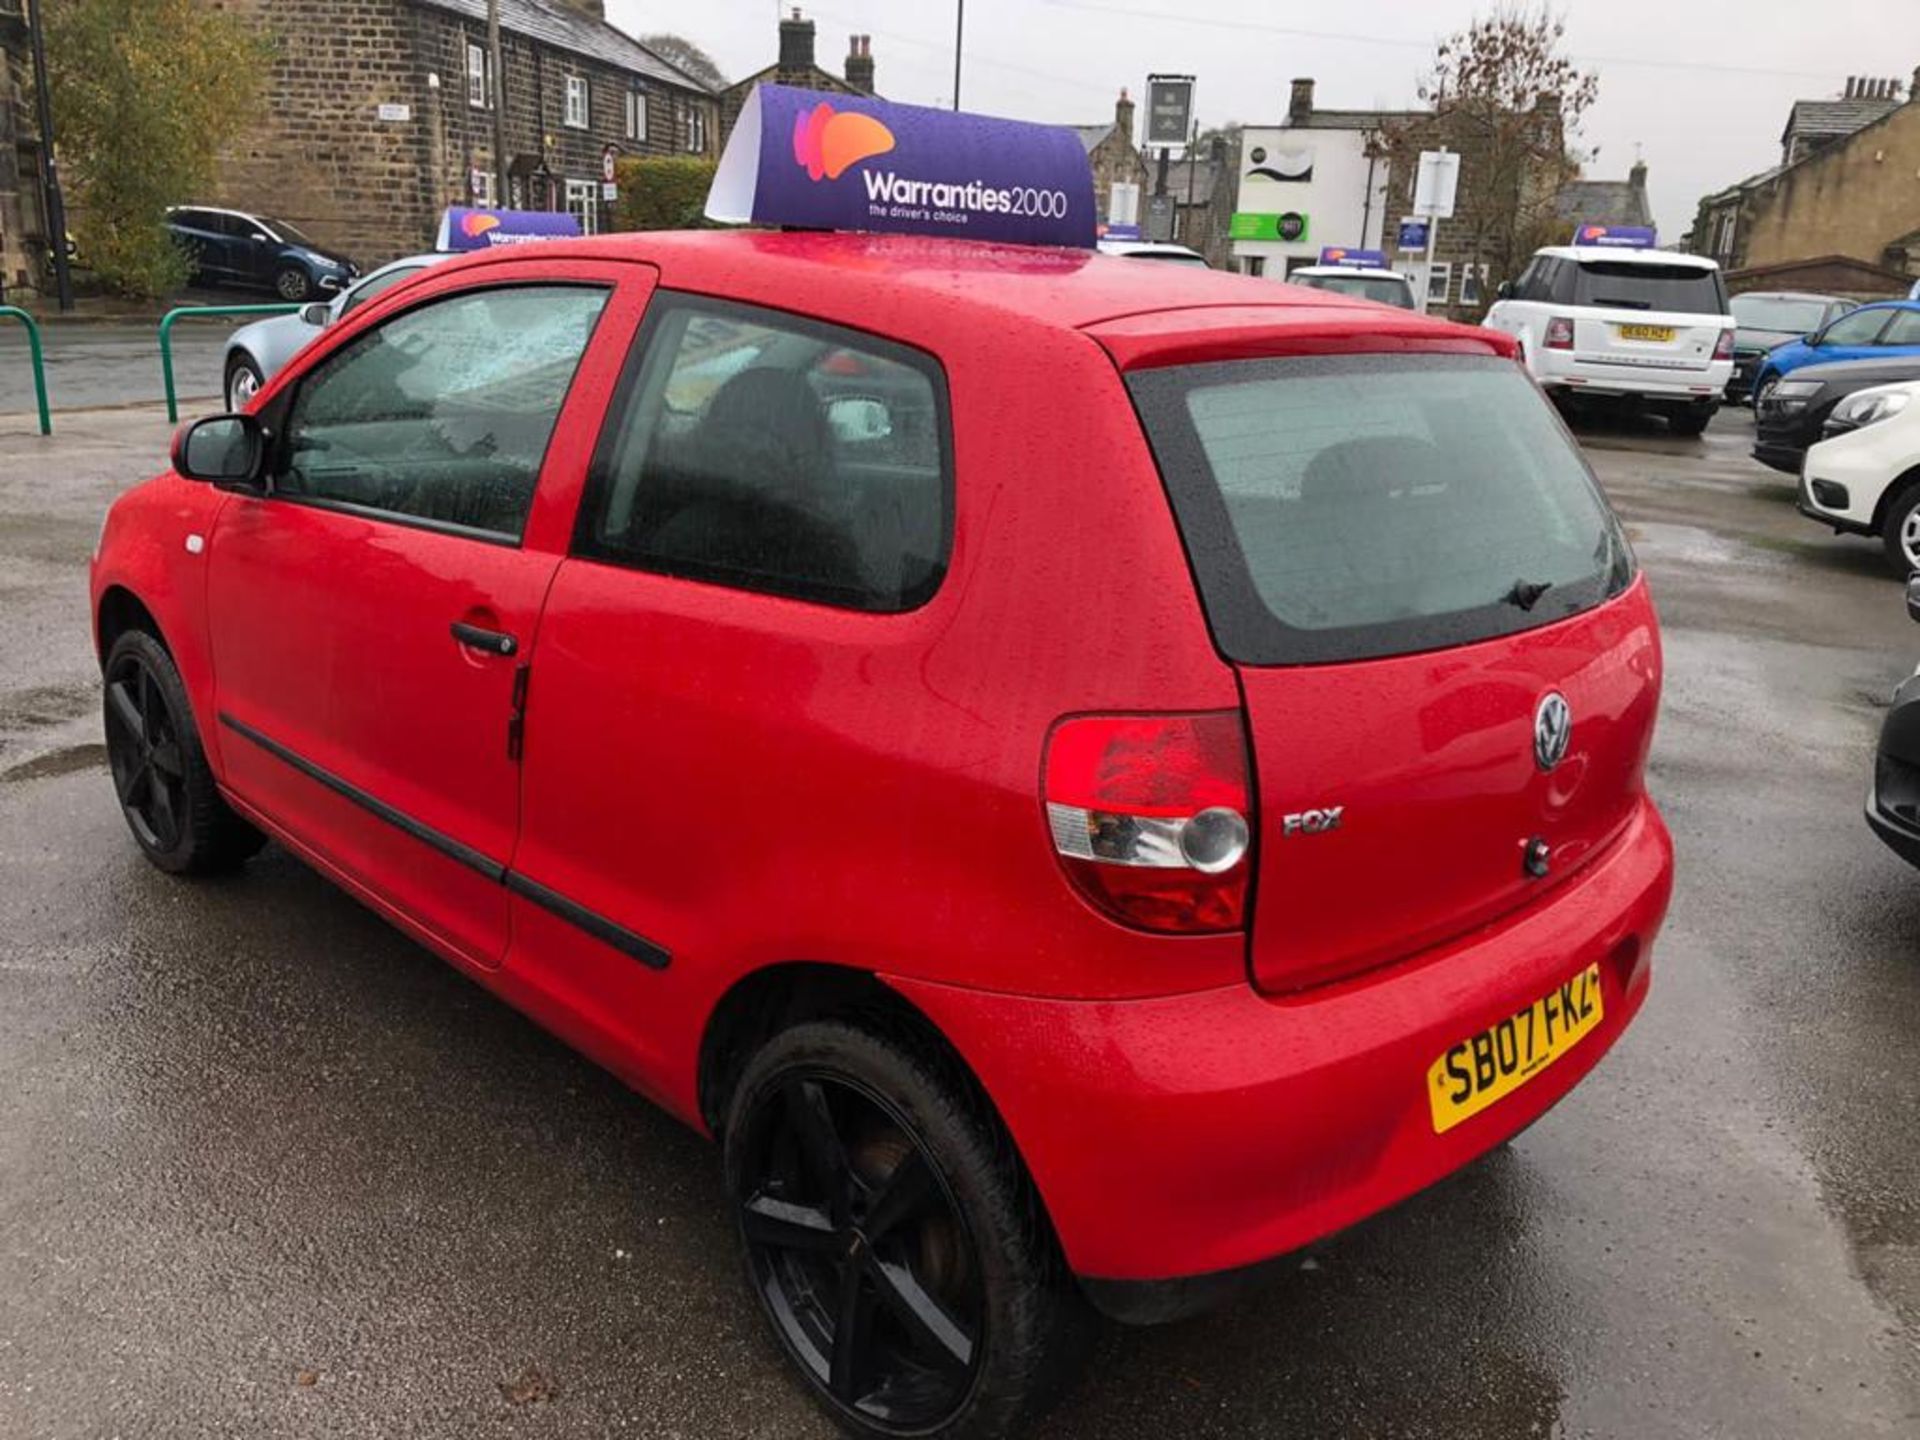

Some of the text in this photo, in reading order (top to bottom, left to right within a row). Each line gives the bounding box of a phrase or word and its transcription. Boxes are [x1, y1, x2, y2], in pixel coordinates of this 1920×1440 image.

[863, 169, 1067, 219] Warranties2000
[869, 204, 968, 224] the driver's choice
[1283, 806, 1344, 838] FOX
[1445, 1006, 1534, 1105] SB07
